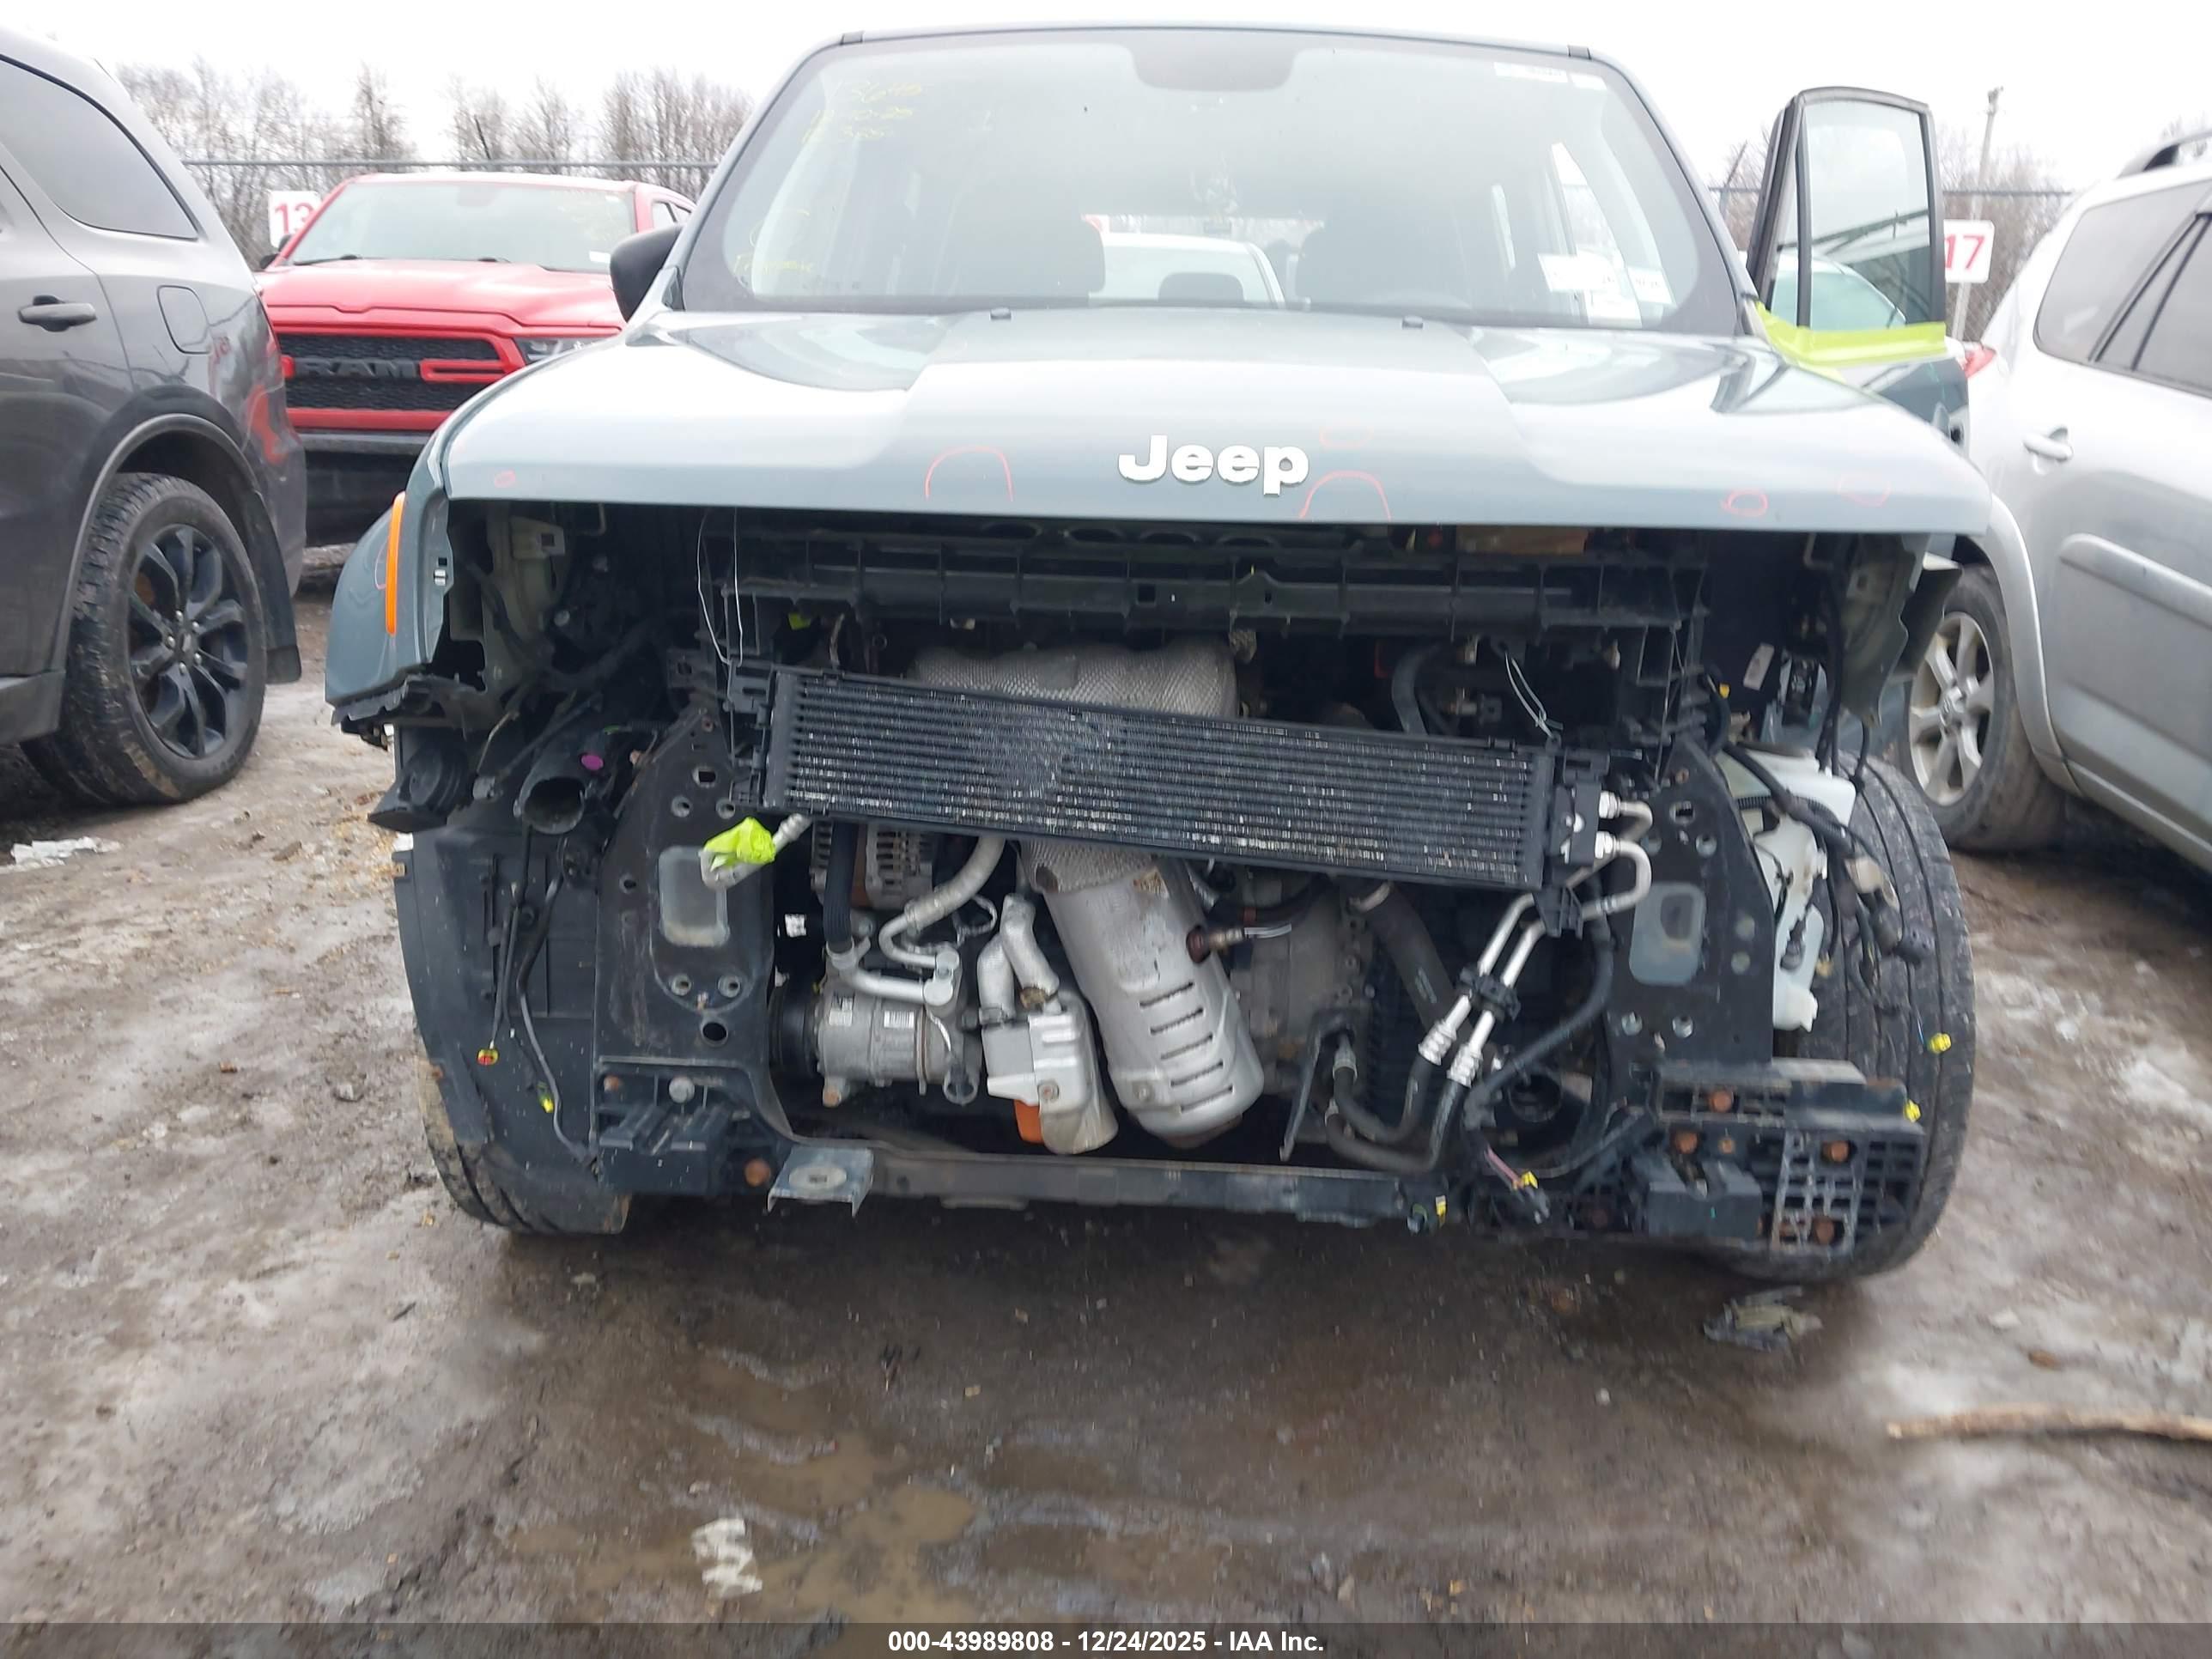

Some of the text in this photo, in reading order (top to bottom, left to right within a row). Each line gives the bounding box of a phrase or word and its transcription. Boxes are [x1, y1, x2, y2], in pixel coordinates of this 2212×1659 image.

[1944, 233, 1985, 270] 17
[295, 356, 416, 379] RAM
[1118, 434, 1309, 497] Jeep
